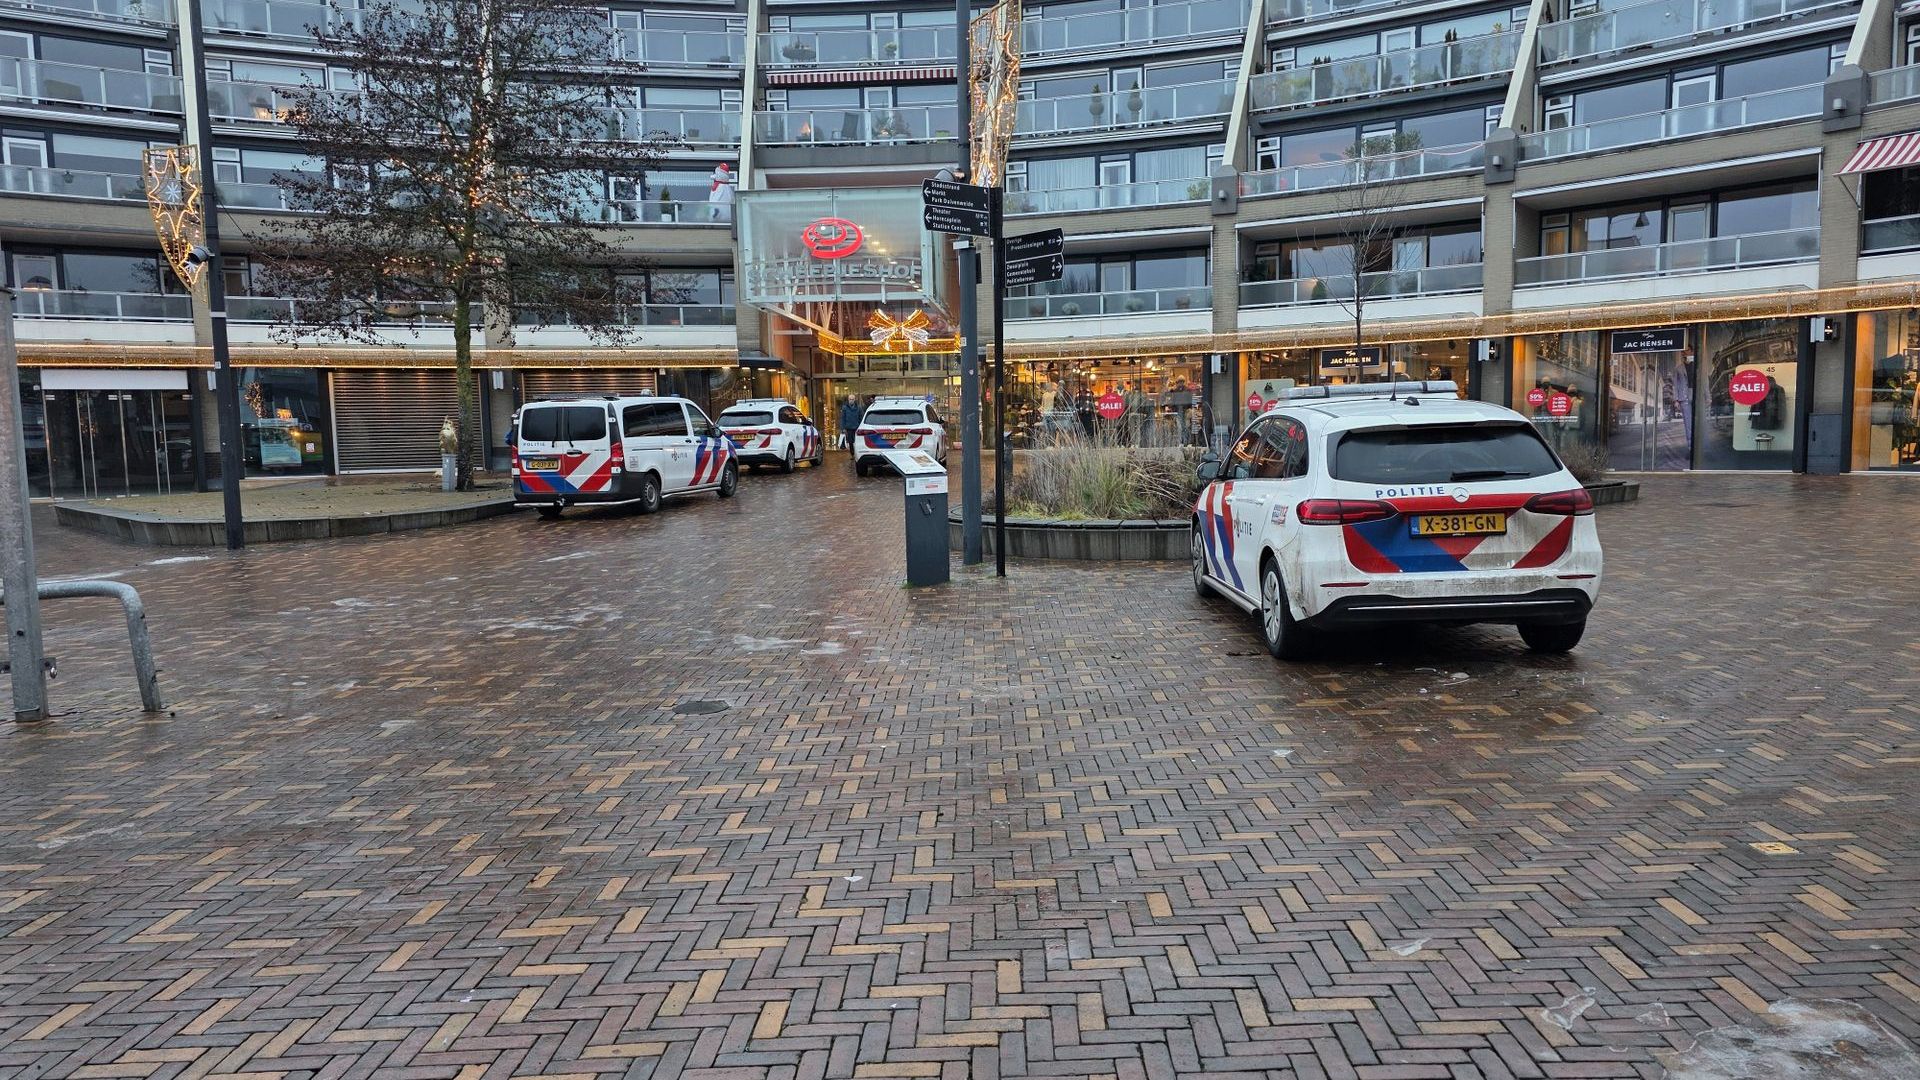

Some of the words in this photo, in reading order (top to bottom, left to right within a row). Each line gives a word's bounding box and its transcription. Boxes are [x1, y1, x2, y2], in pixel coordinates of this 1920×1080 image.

[950, 225, 971, 233] Centrum
[1640, 339, 1673, 347] HENSEN
[1732, 383, 1765, 392] SALE!
[1100, 402, 1122, 410] SALE!
[1375, 486, 1445, 498] POLITIE
[1425, 516, 1497, 532] X-381-GN
